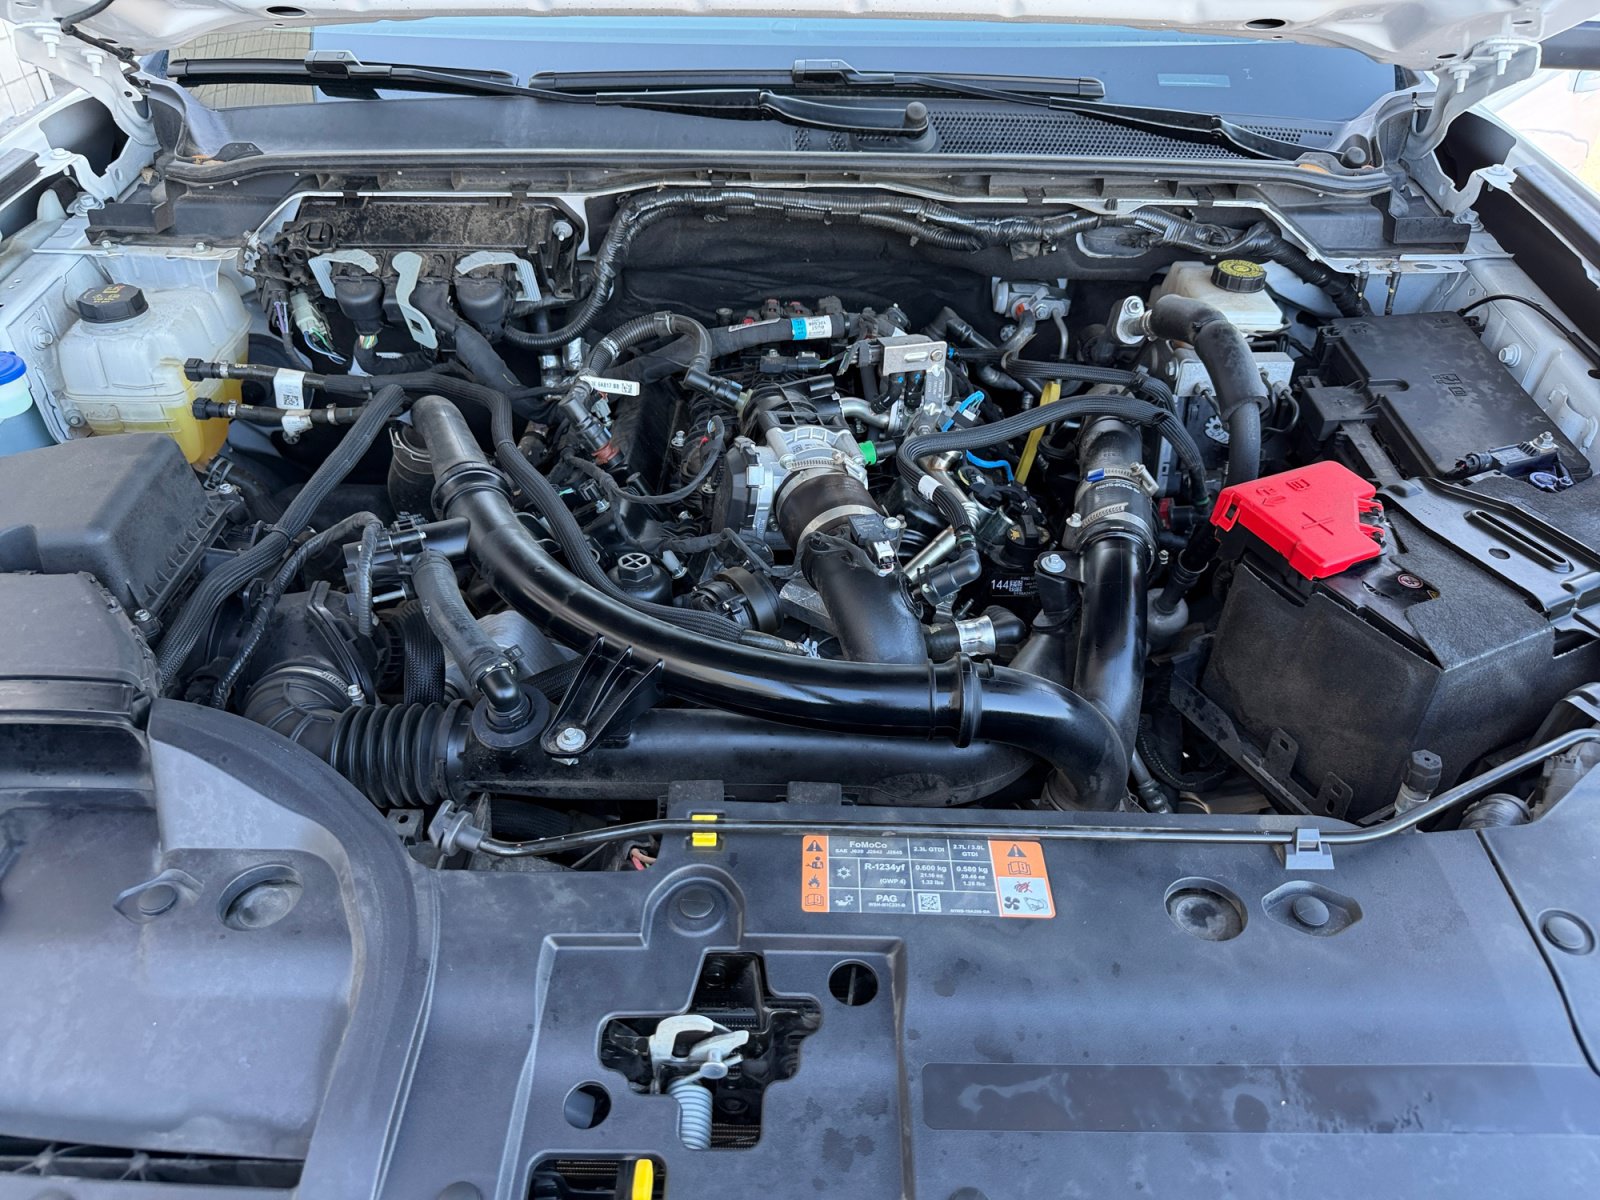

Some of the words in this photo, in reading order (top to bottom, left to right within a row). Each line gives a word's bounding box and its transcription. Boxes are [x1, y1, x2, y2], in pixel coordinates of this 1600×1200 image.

[991, 579, 1009, 590] 144
[849, 841, 888, 849] FoMoCo
[864, 862, 906, 872] R-1234yf
[937, 864, 947, 873] kg
[978, 866, 989, 874] kg
[876, 894, 898, 903] PAG
